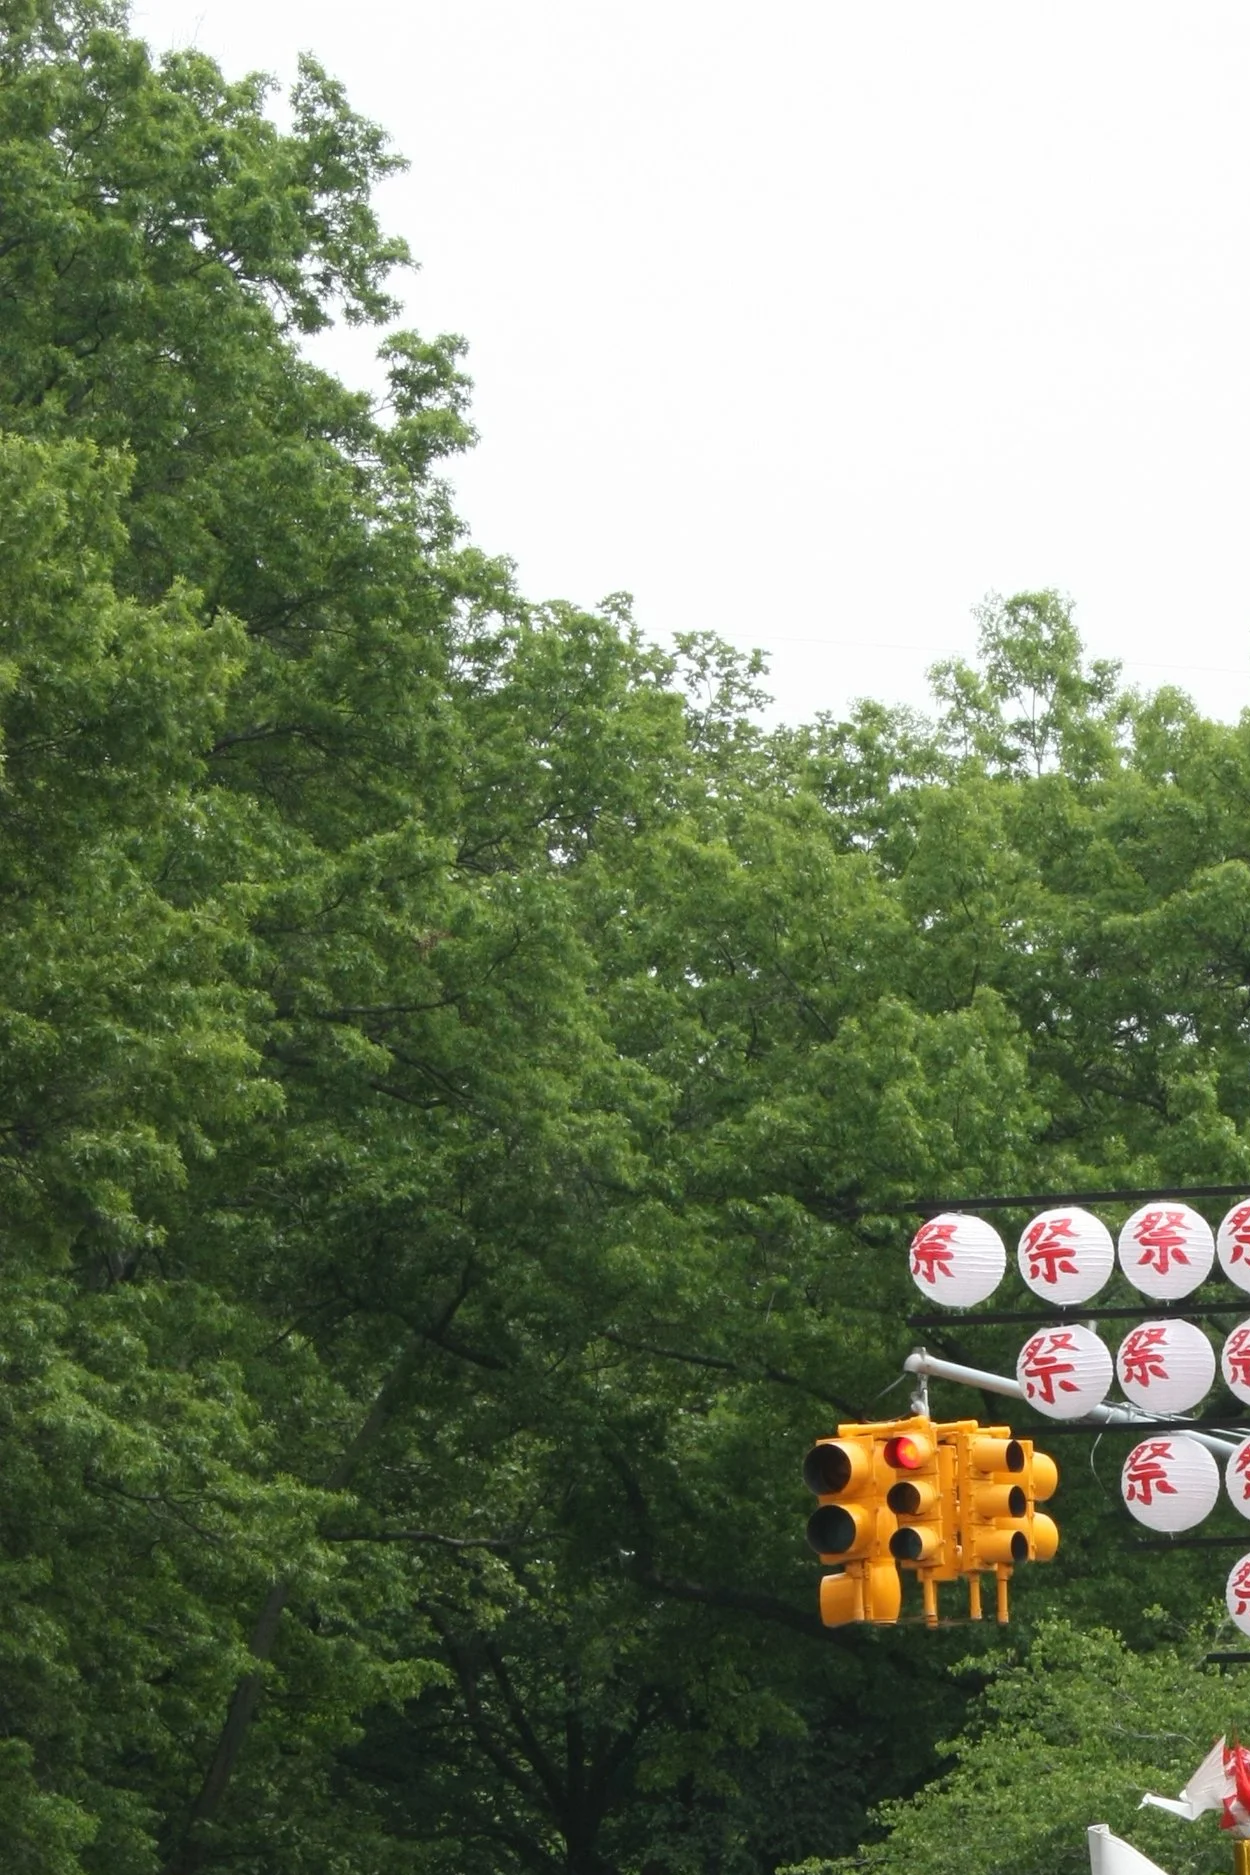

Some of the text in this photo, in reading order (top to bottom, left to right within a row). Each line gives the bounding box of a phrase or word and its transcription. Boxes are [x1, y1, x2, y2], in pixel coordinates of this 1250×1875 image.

[912, 1223, 957, 1285] 祭
[1025, 1217, 1078, 1284] 祭
[1135, 1211, 1190, 1276] 祭
[1023, 1332, 1079, 1405] 祭
[1122, 1327, 1169, 1388] 祭
[1126, 1440, 1177, 1505] 祭
